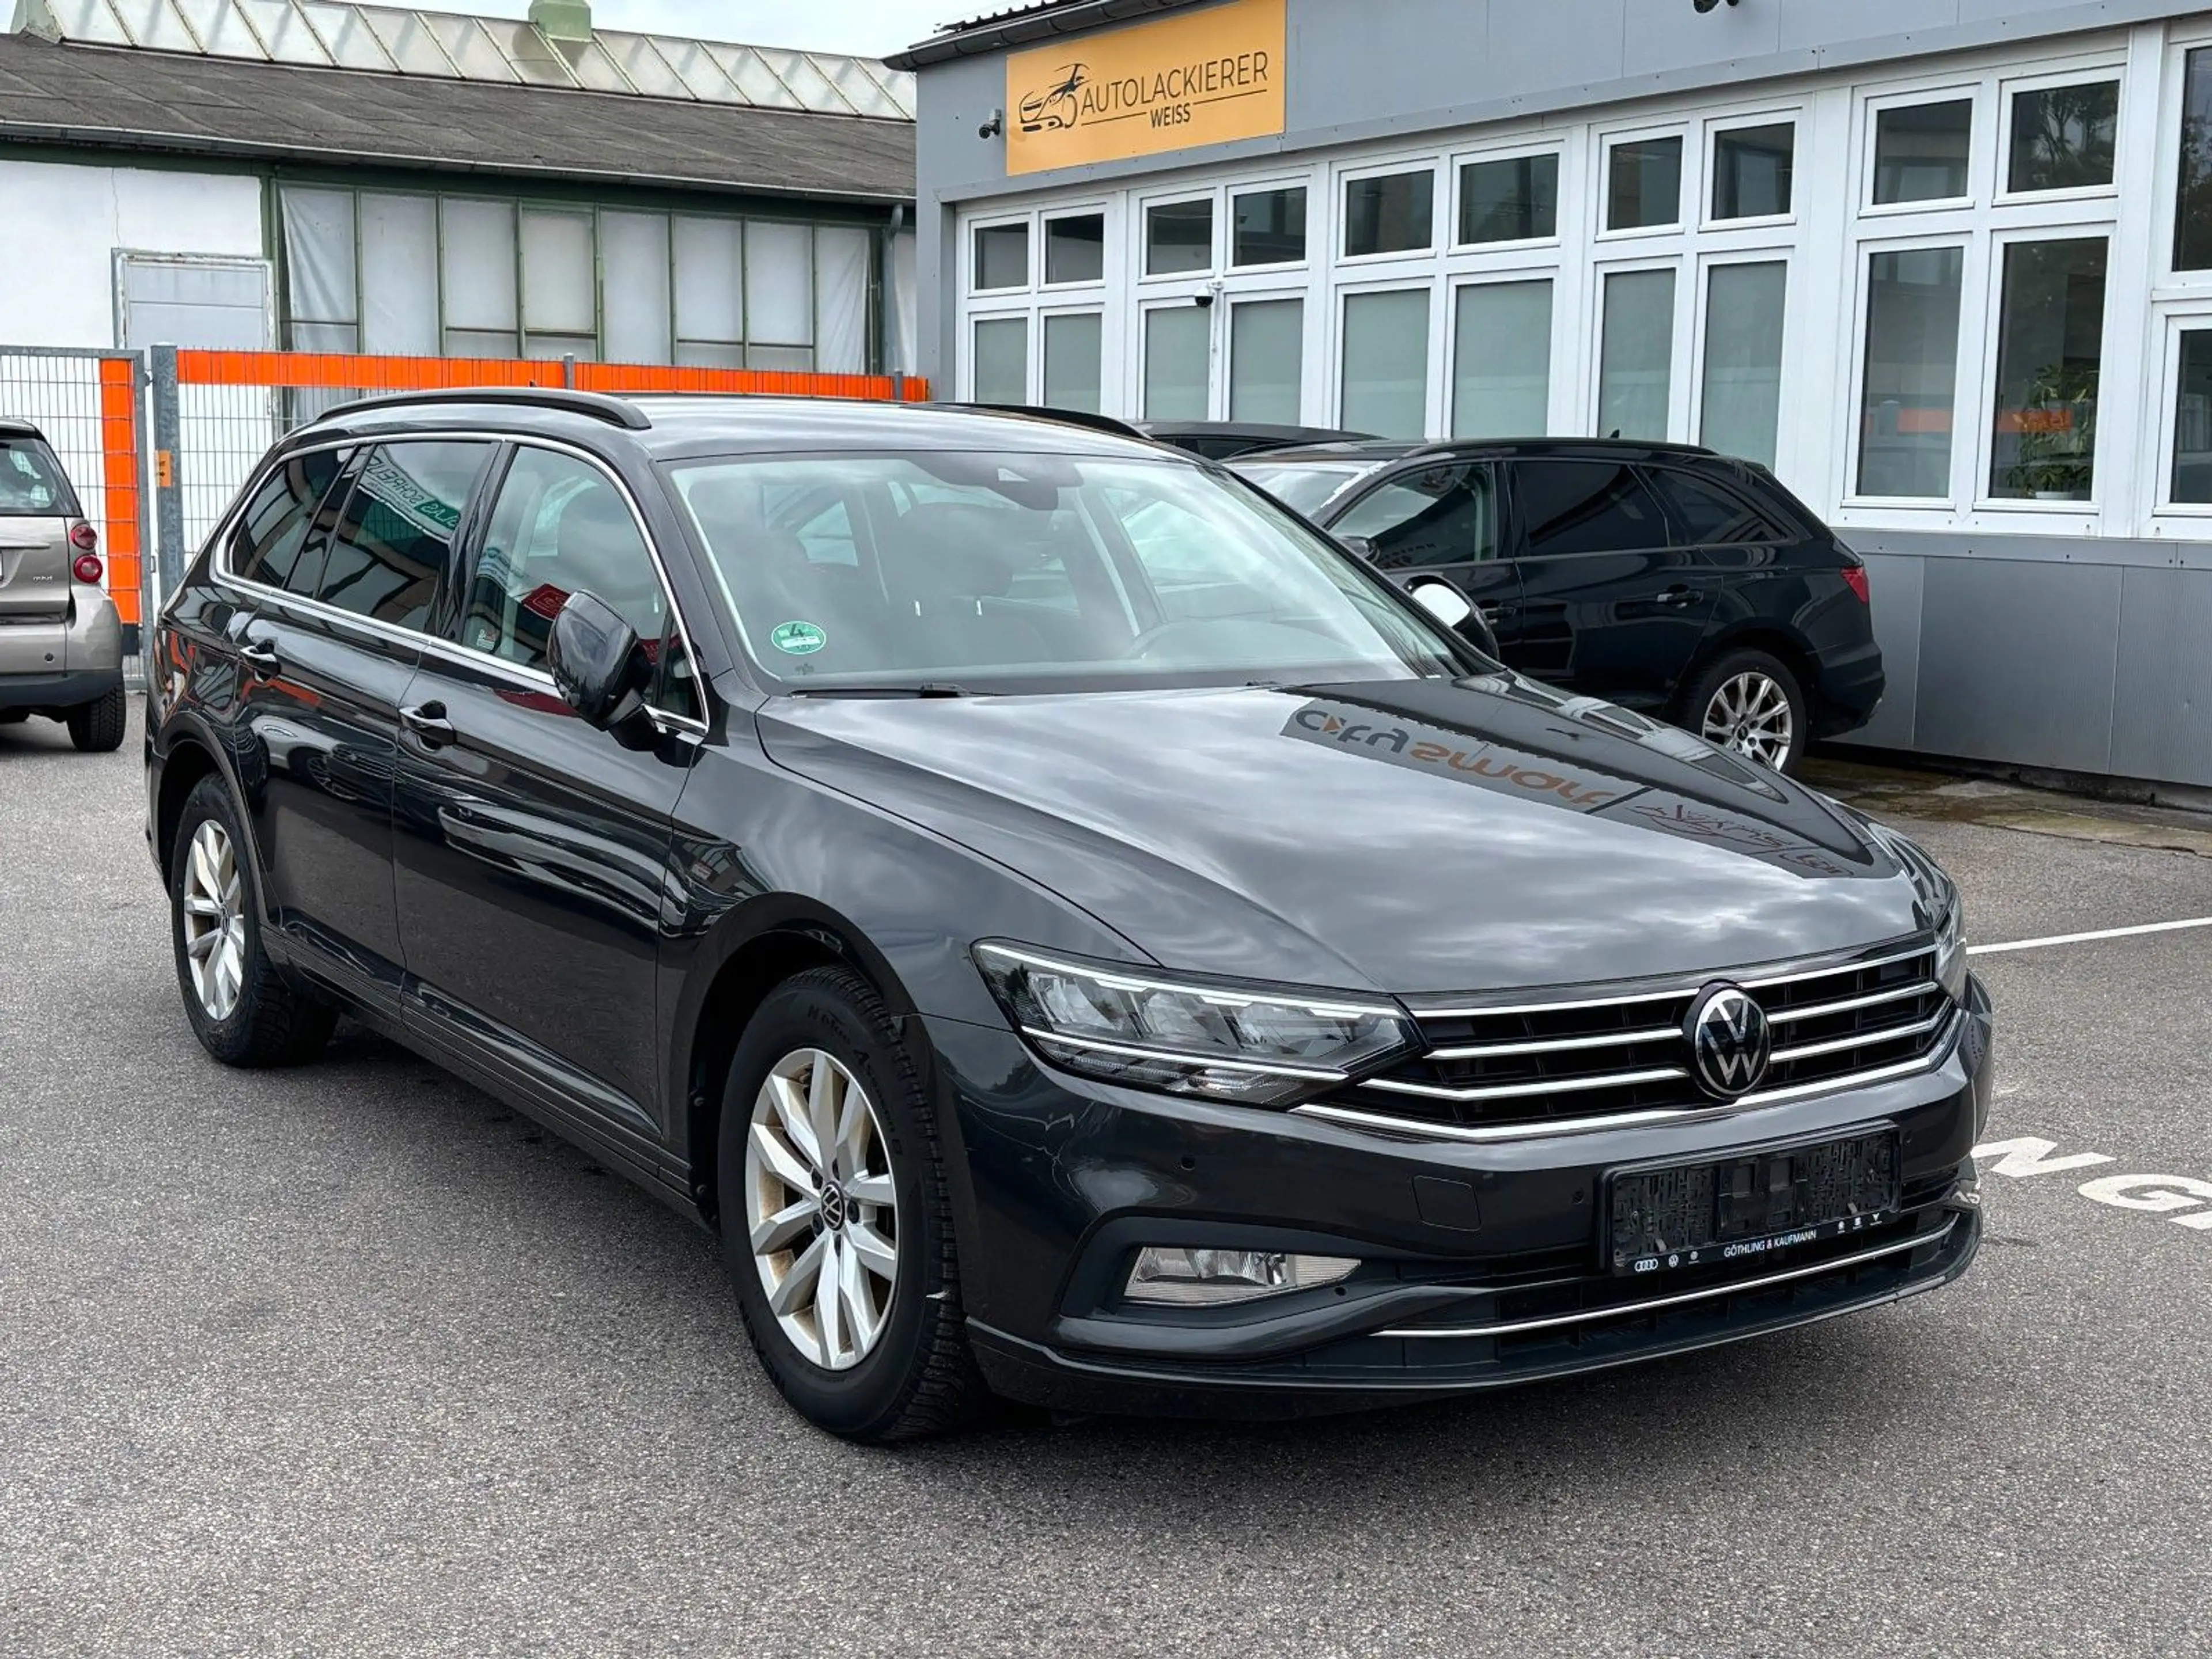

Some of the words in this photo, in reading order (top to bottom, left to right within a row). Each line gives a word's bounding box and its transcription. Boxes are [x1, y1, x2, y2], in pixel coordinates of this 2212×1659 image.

[1081, 51, 1268, 115] AUTOLACKIERER
[1150, 102, 1191, 128] WEISS
[790, 624, 805, 637] 4
[1724, 1240, 1765, 1257] GÖTHLING
[1766, 1238, 1773, 1249] &
[1774, 1230, 1817, 1248] KAUFMANN
